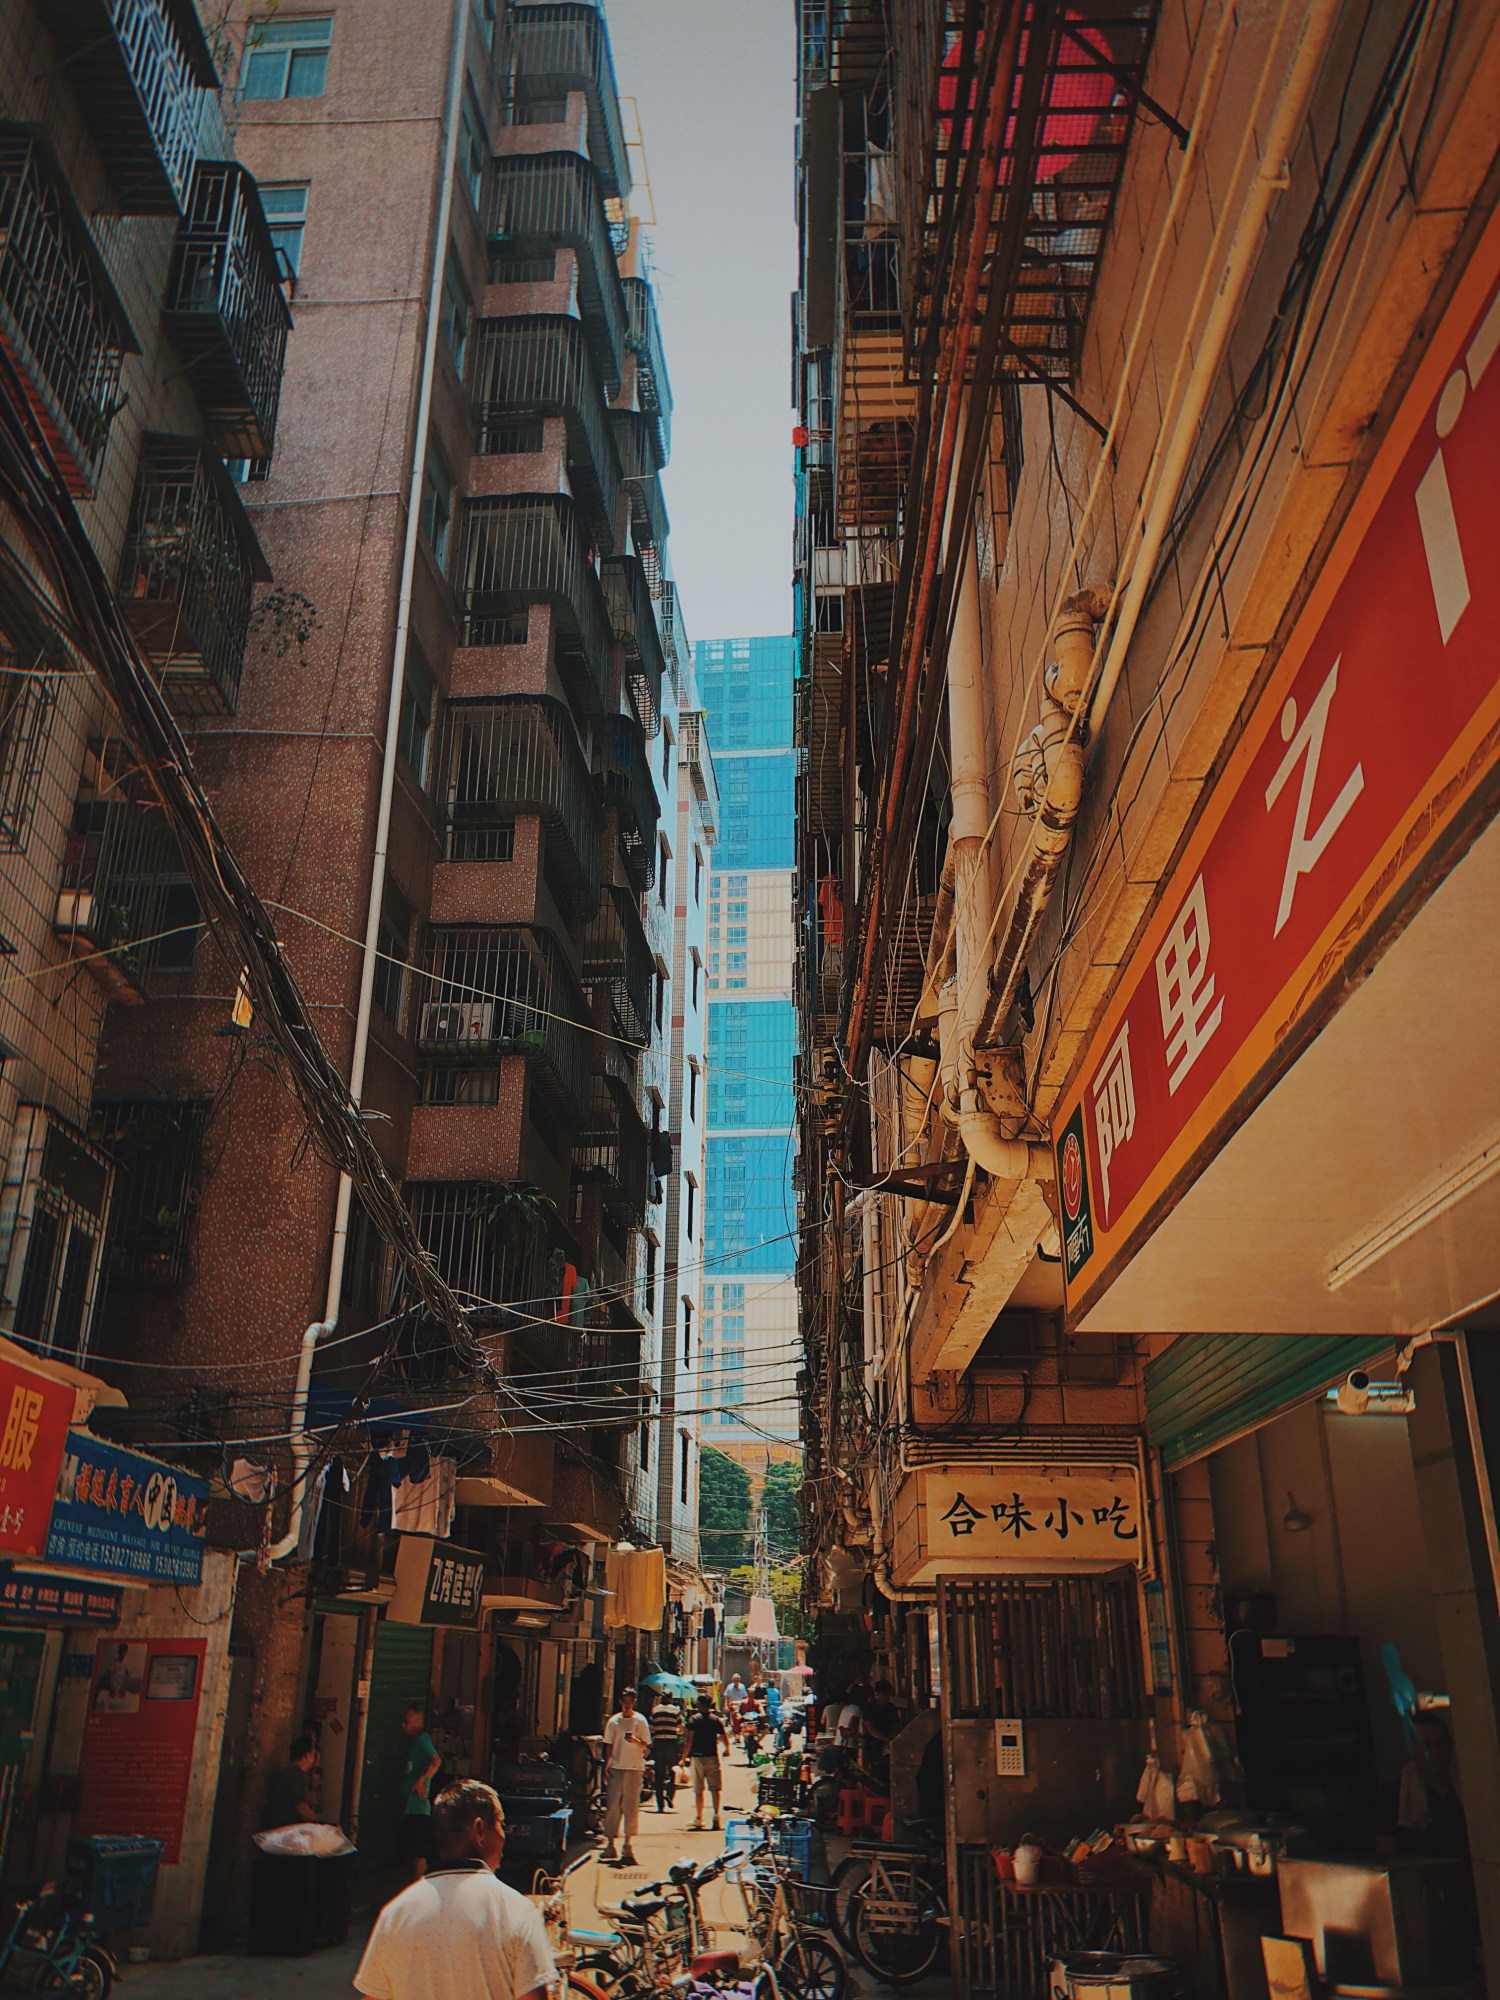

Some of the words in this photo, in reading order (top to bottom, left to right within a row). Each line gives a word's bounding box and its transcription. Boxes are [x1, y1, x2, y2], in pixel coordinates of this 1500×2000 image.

[0, 1384, 44, 1472] 服
[54, 1518, 83, 1534] CHINESE
[88, 1526, 118, 1542] MEDICINE
[123, 1533, 147, 1549] MASSAGE
[940, 1492, 1138, 1540] 合味小吃
